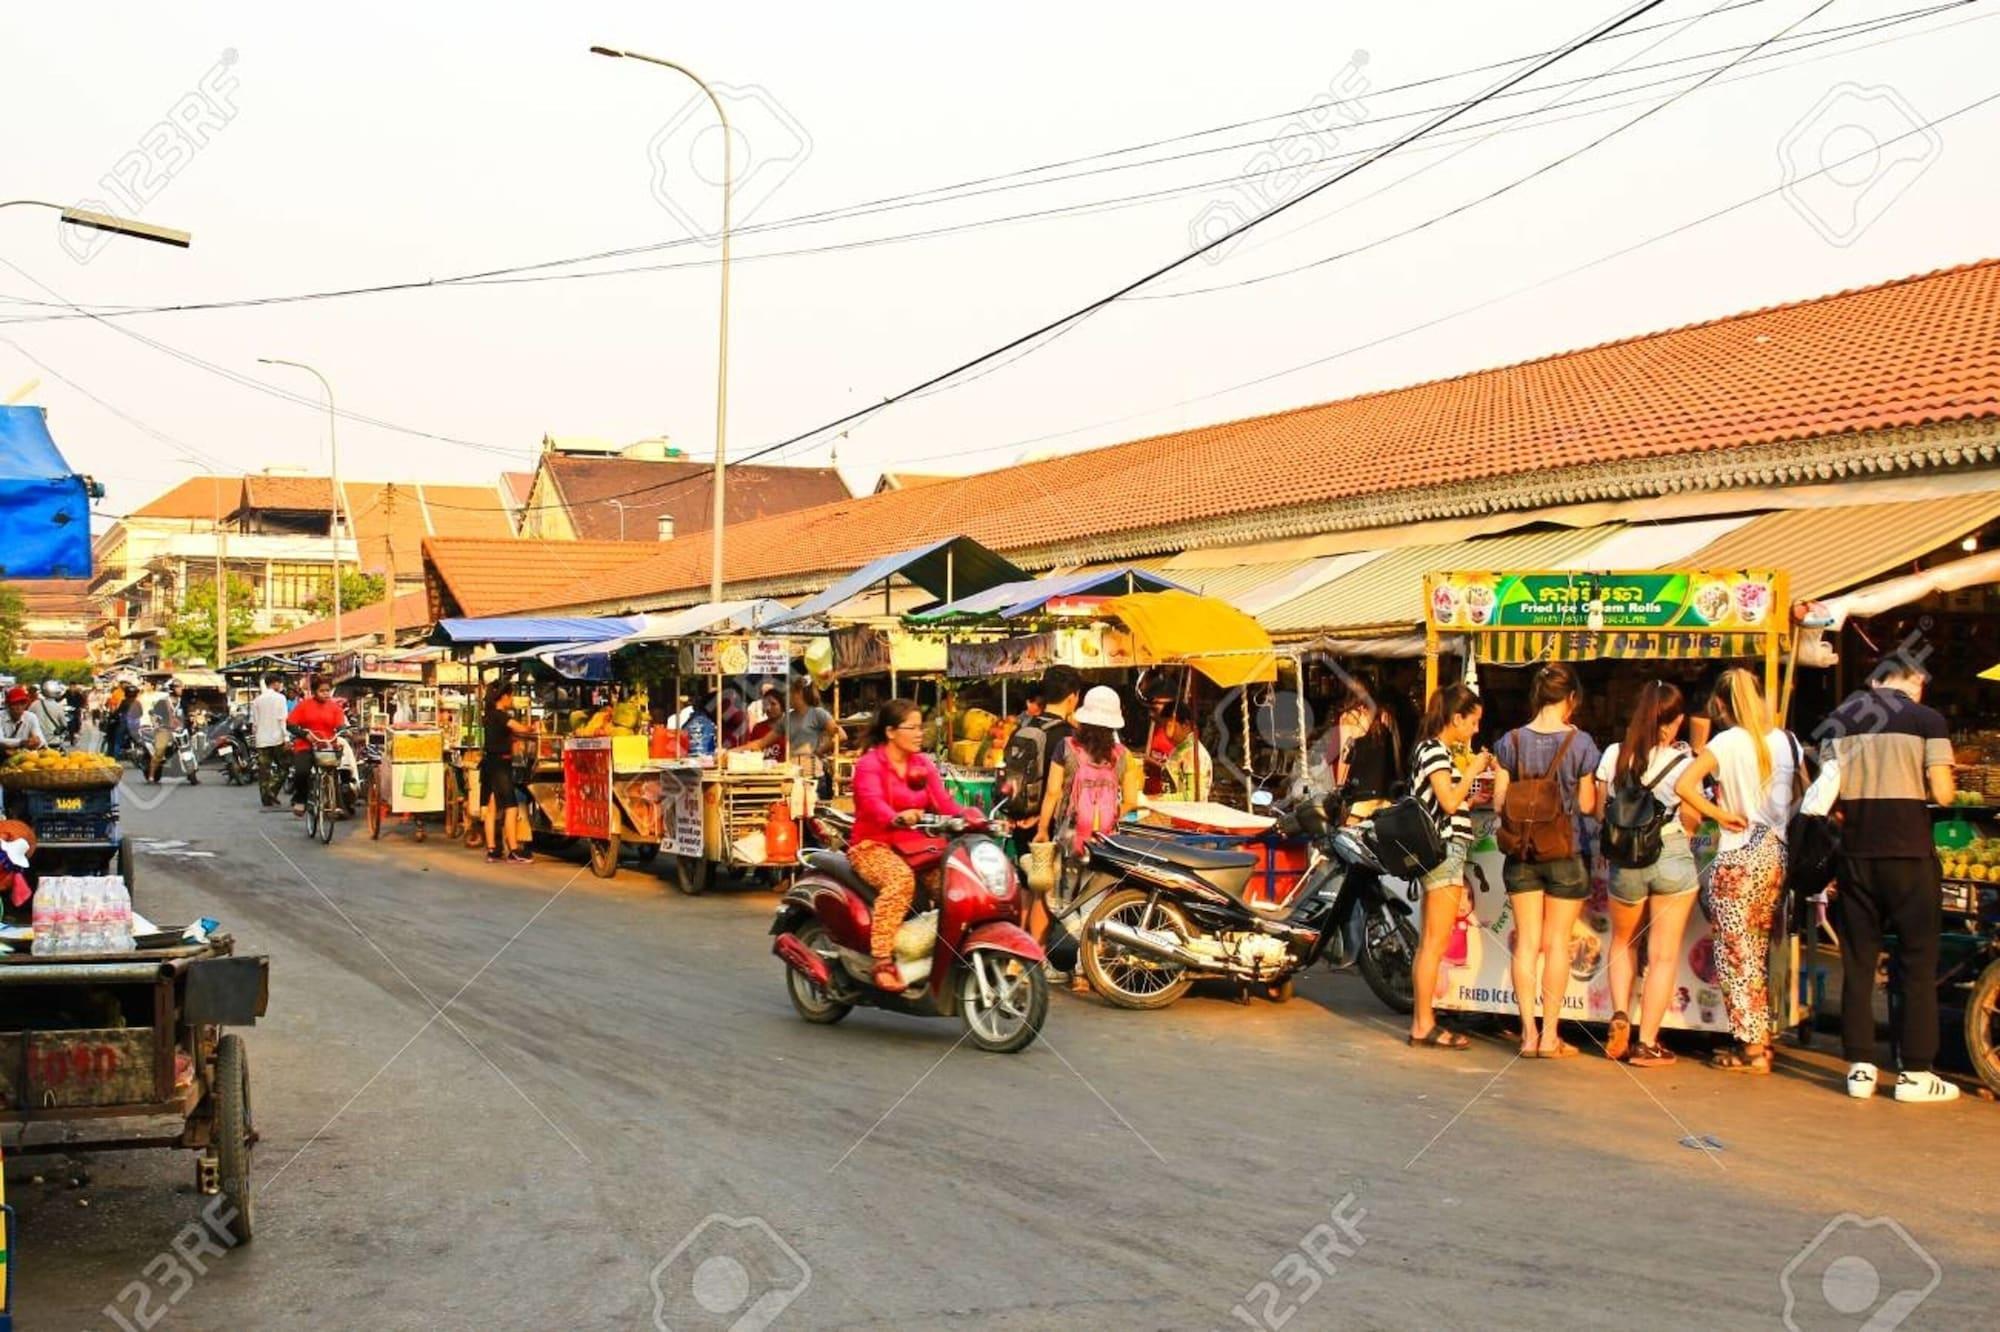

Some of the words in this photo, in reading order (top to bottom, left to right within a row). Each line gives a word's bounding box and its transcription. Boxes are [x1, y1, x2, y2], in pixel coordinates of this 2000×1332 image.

[1520, 603, 1553, 614] Fried
[1557, 603, 1577, 614] Ice
[1581, 603, 1624, 614] Cam
[1629, 603, 1662, 614] Rolls
[1459, 985, 1489, 1001] FRIED
[1491, 988, 1512, 1004] ICE
